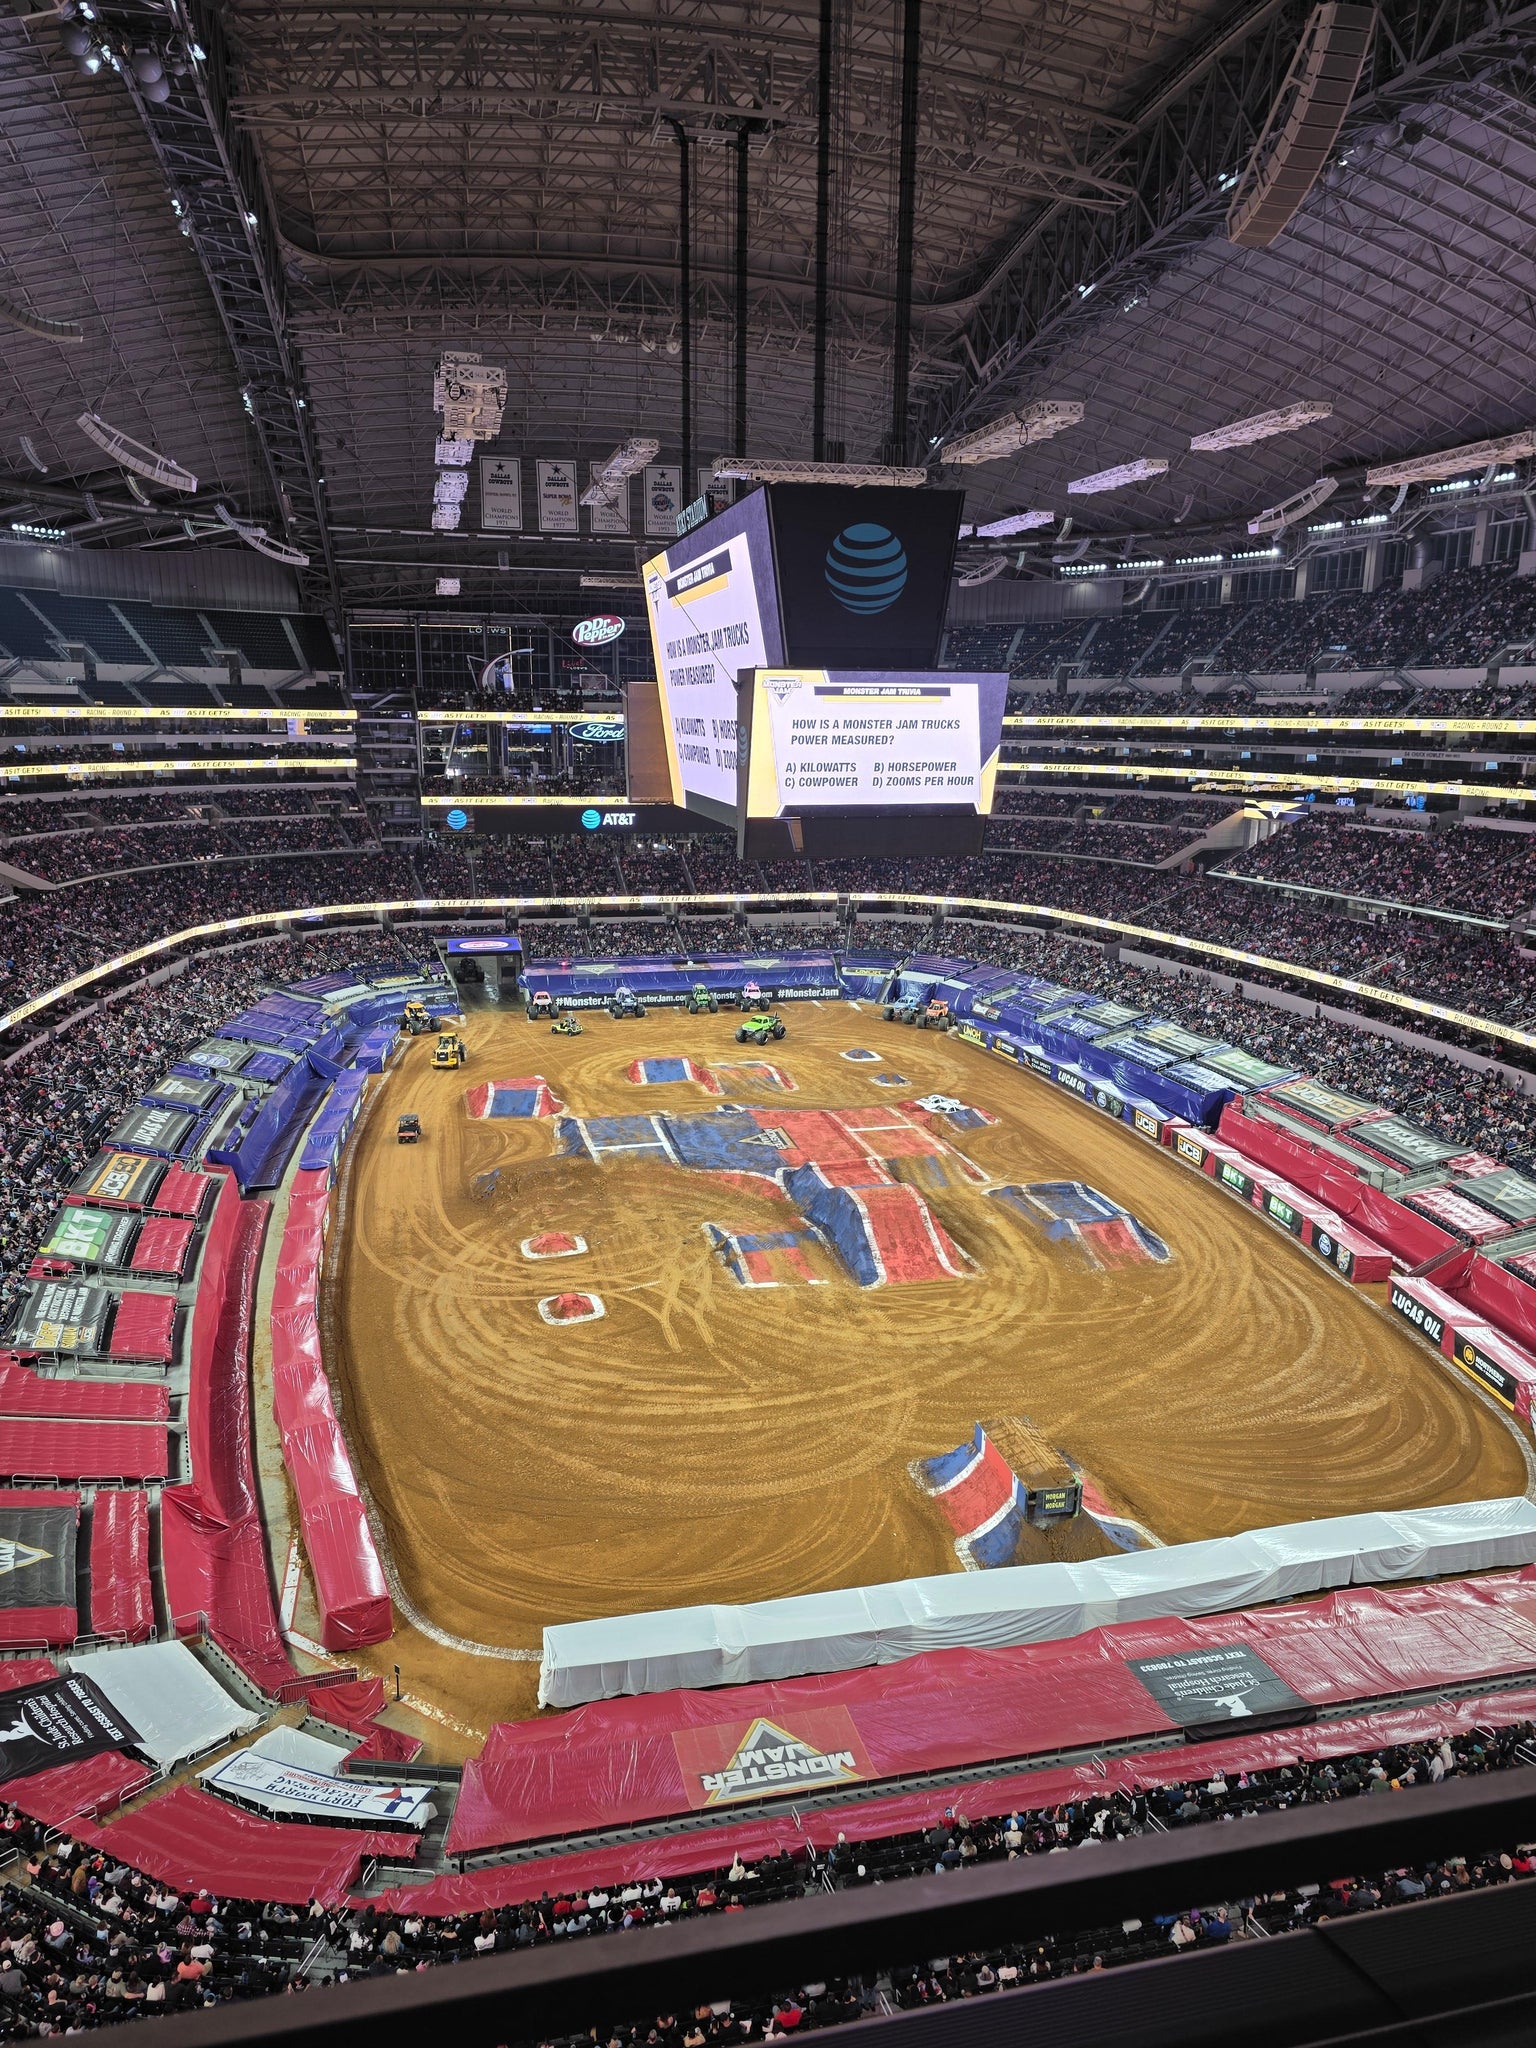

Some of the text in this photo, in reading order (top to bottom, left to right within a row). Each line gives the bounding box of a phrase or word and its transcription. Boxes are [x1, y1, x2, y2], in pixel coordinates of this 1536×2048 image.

[577, 621, 622, 644] Pepper
[592, 617, 611, 631] Dr
[666, 640, 677, 660] HOW
[676, 639, 683, 658] IS
[685, 632, 712, 656] MONSTER
[710, 628, 725, 652] JAM
[723, 621, 750, 649] TRUCKS
[669, 663, 716, 687] POWER MEASURED?
[762, 680, 802, 688] MONSTER
[843, 687, 922, 696] MONSTER JAM TRIVIA
[559, 723, 624, 738] Ford
[675, 717, 720, 743] A) KILOWATTS B)
[792, 719, 961, 730] HOW IS A MONSTER JAM TRUCKS
[791, 735, 895, 745] POWER MEASURED?
[678, 742, 723, 772] C) COWPOWER D)
[785, 761, 957, 774] A) KILOWATTS B) HORSEPOWER
[784, 776, 974, 789] C) COWPOWER D) ZOOMS PER HOUR
[602, 812, 636, 826] AT&T
[777, 988, 839, 998] #MonsterJam
[1332, 978, 1343, 987] AS
[1358, 986, 1369, 994] AS
[1380, 991, 1403, 1003] GETS!
[962, 1024, 982, 1039] UNOH
[1453, 1013, 1515, 1039] RACING ROUND 2
[1057, 1070, 1087, 1095] LUCAS OIL
[1291, 1085, 1333, 1105] JCB
[131, 1109, 173, 1146] LUCAS OIL
[1135, 1114, 1157, 1134] JCB
[1179, 1142, 1201, 1161] JCB
[97, 1170, 130, 1197] JCB
[1223, 1164, 1244, 1187] BKT
[1270, 1197, 1293, 1222] BKT
[56, 1209, 103, 1258] BKT
[113, 1216, 129, 1242] TOGETHER
[1391, 1290, 1425, 1325] LUCAS
[1475, 1355, 1506, 1384] NORTHERN
[1045, 1492, 1066, 1501] MORGAN
[1045, 1501, 1065, 1510] MORGAN
[1140, 1650, 1247, 1673] TEXT SCSEAST TO 785833
[1167, 1671, 1254, 1692] Research Hospital
[1174, 1678, 1261, 1699] St. Jude Children's
[80, 1698, 94, 1709] TO
[23, 1697, 70, 1750] St. Jude Children's
[35, 1694, 84, 1746] Research Hospital
[85, 1704, 114, 1731] SCSEAST
[106, 1728, 125, 1742] TEXT
[738, 1742, 807, 1768] JAM
[701, 1751, 856, 1791] MONSTER
[264, 1783, 365, 1809] FORT WORTH
[271, 1775, 369, 1800] EXCAVATING
